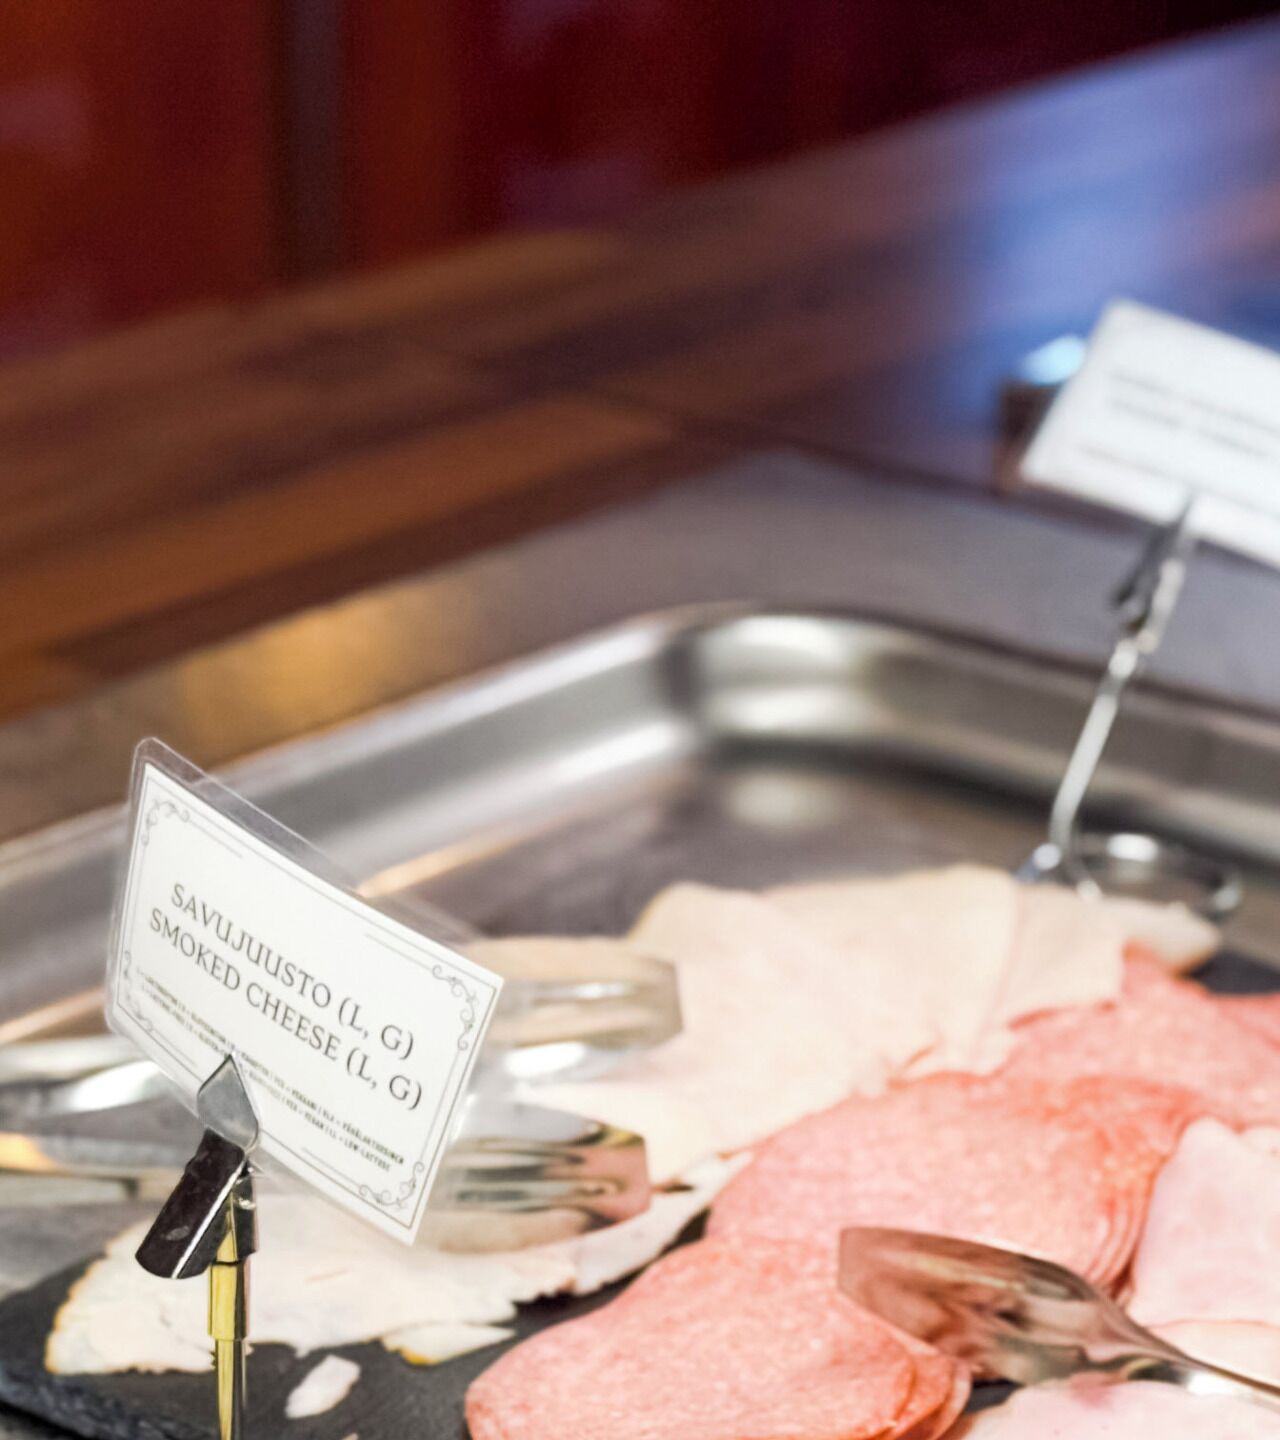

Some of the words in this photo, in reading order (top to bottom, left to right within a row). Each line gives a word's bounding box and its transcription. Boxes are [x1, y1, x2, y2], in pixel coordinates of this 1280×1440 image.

[150, 909, 240, 991] SMOKED
[247, 982, 338, 1062] CHEESE
[347, 1047, 378, 1091] (L,
[389, 1074, 422, 1110] G)
[171, 883, 332, 1009] SAVUJUUSTO
[338, 996, 369, 1037] (L,
[381, 1023, 414, 1060] G)
